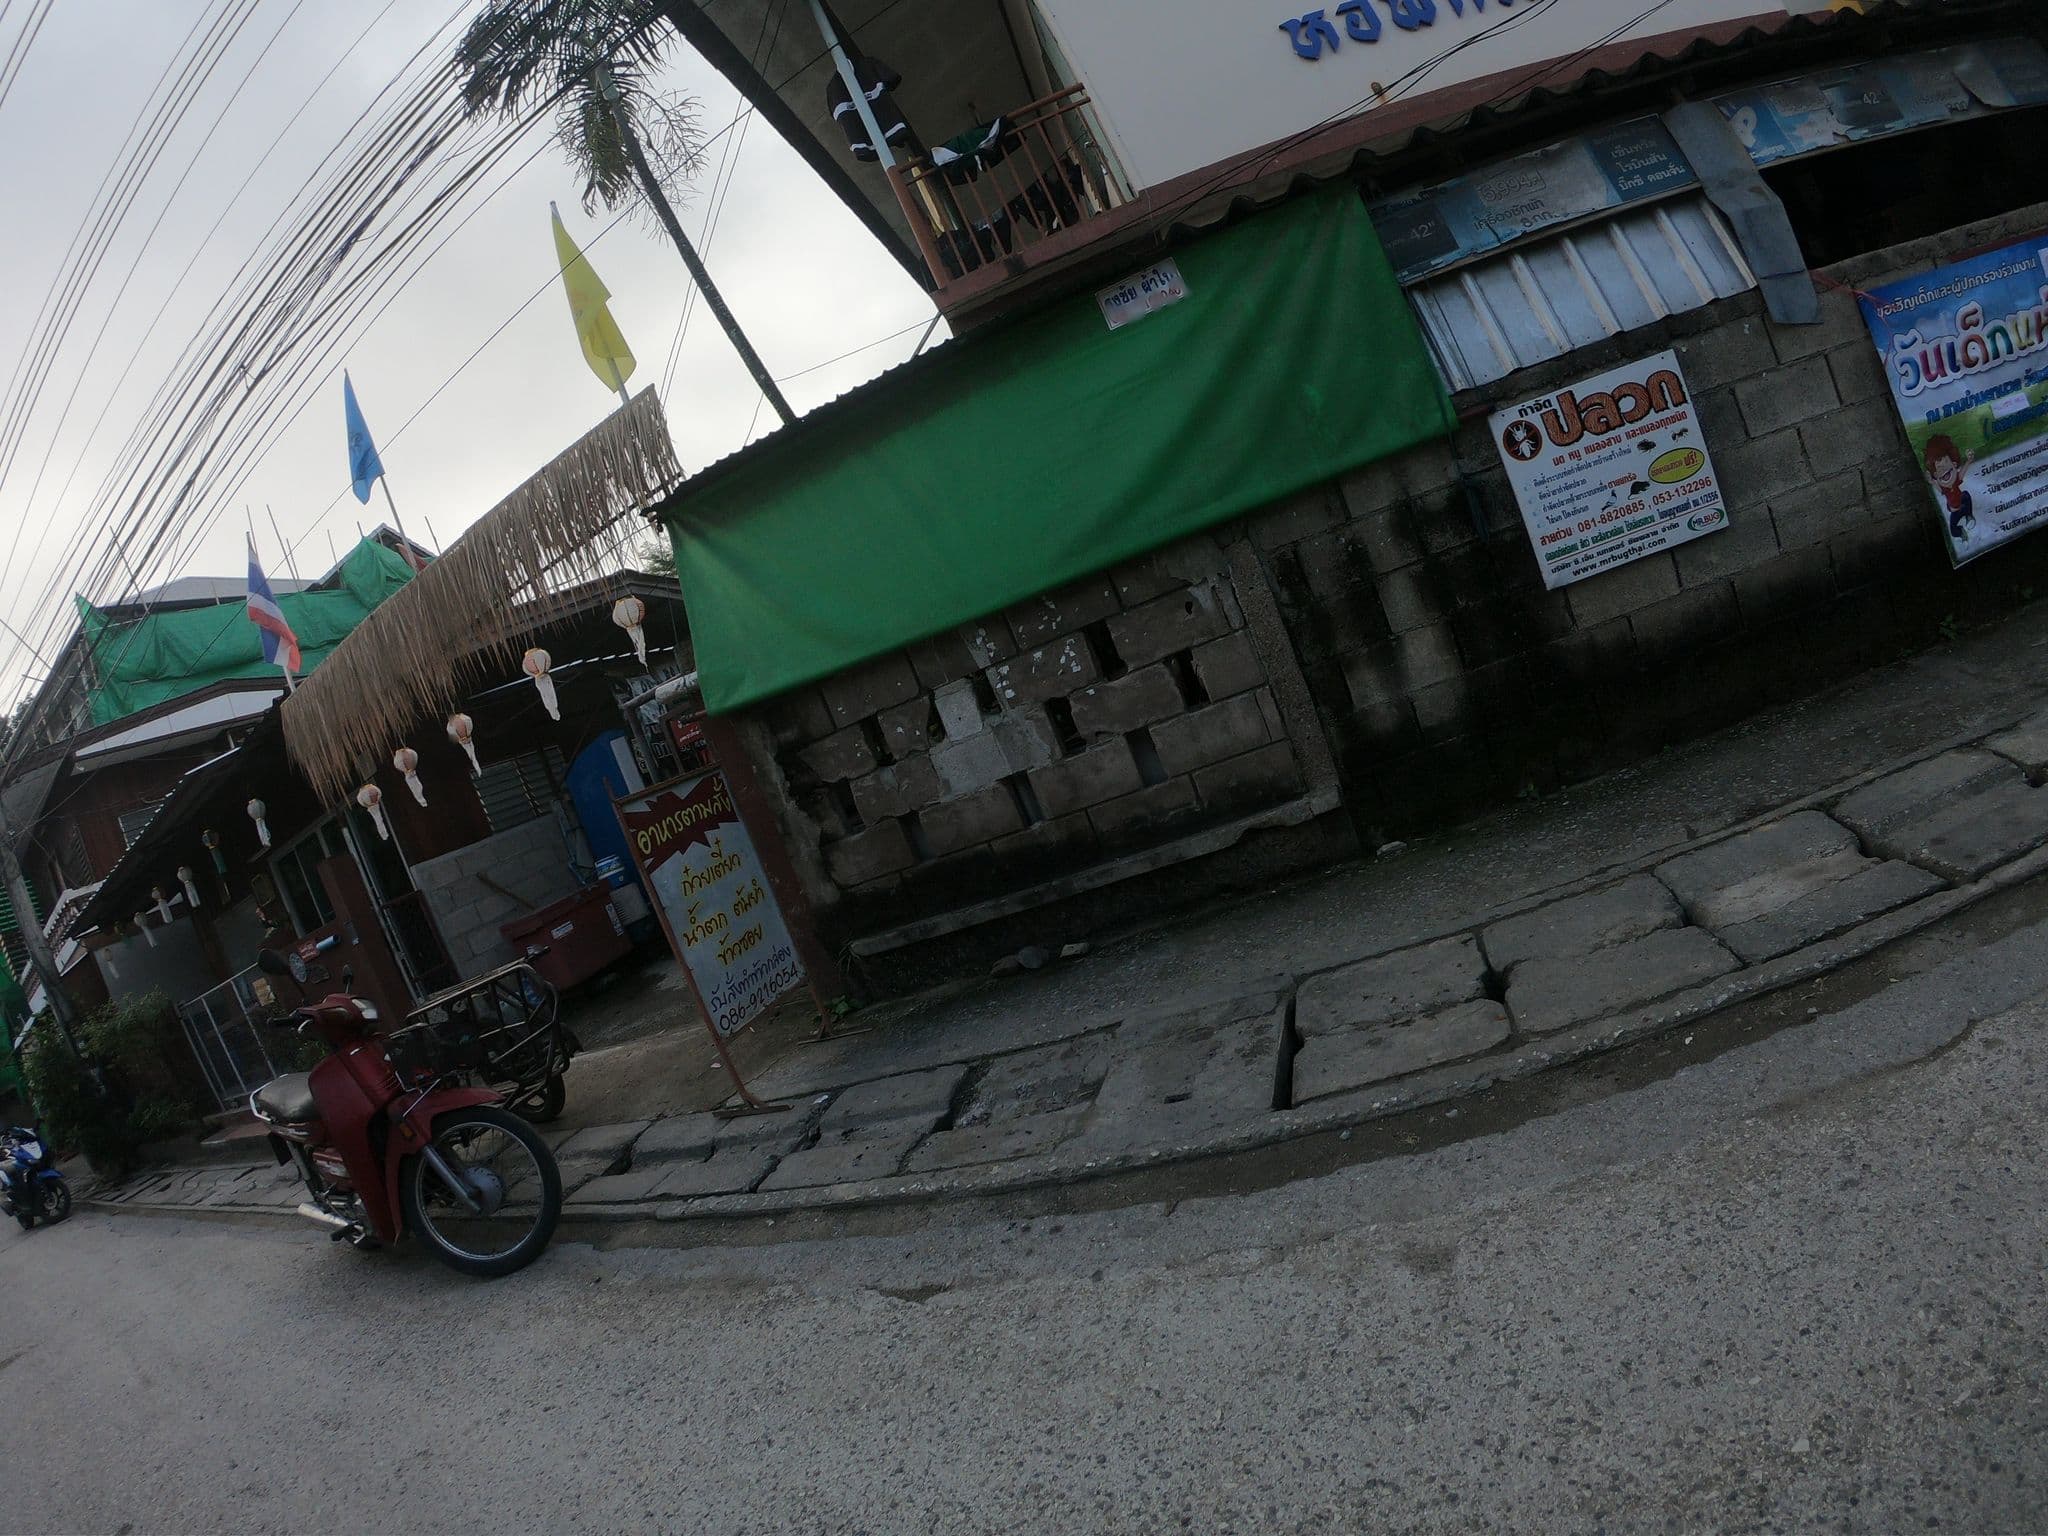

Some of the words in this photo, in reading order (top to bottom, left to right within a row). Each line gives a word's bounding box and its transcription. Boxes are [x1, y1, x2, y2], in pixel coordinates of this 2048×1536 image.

[1877, 258, 2037, 317] ขอเชิญเด็กและผู้ปกครองร่วมงาน
[1518, 397, 1553, 418] กำจัด
[1541, 369, 1688, 446] ปลวก
[1553, 454, 1565, 467] มด
[1584, 436, 1622, 456] แมลงสาบ
[1626, 410, 1688, 441] และแมลงทุกชนิด
[1578, 500, 1646, 536] 081-8820885
[1652, 476, 1712, 506] 053-132296
[1572, 536, 1666, 577] www.mrbugthai.com
[638, 777, 731, 855] อาหารตามสั่ง
[684, 902, 728, 947] น้ำตก
[734, 879, 764, 915] ต้มยำ
[718, 928, 762, 966] ข้าวซอย
[720, 965, 798, 1031] 086-9216054
